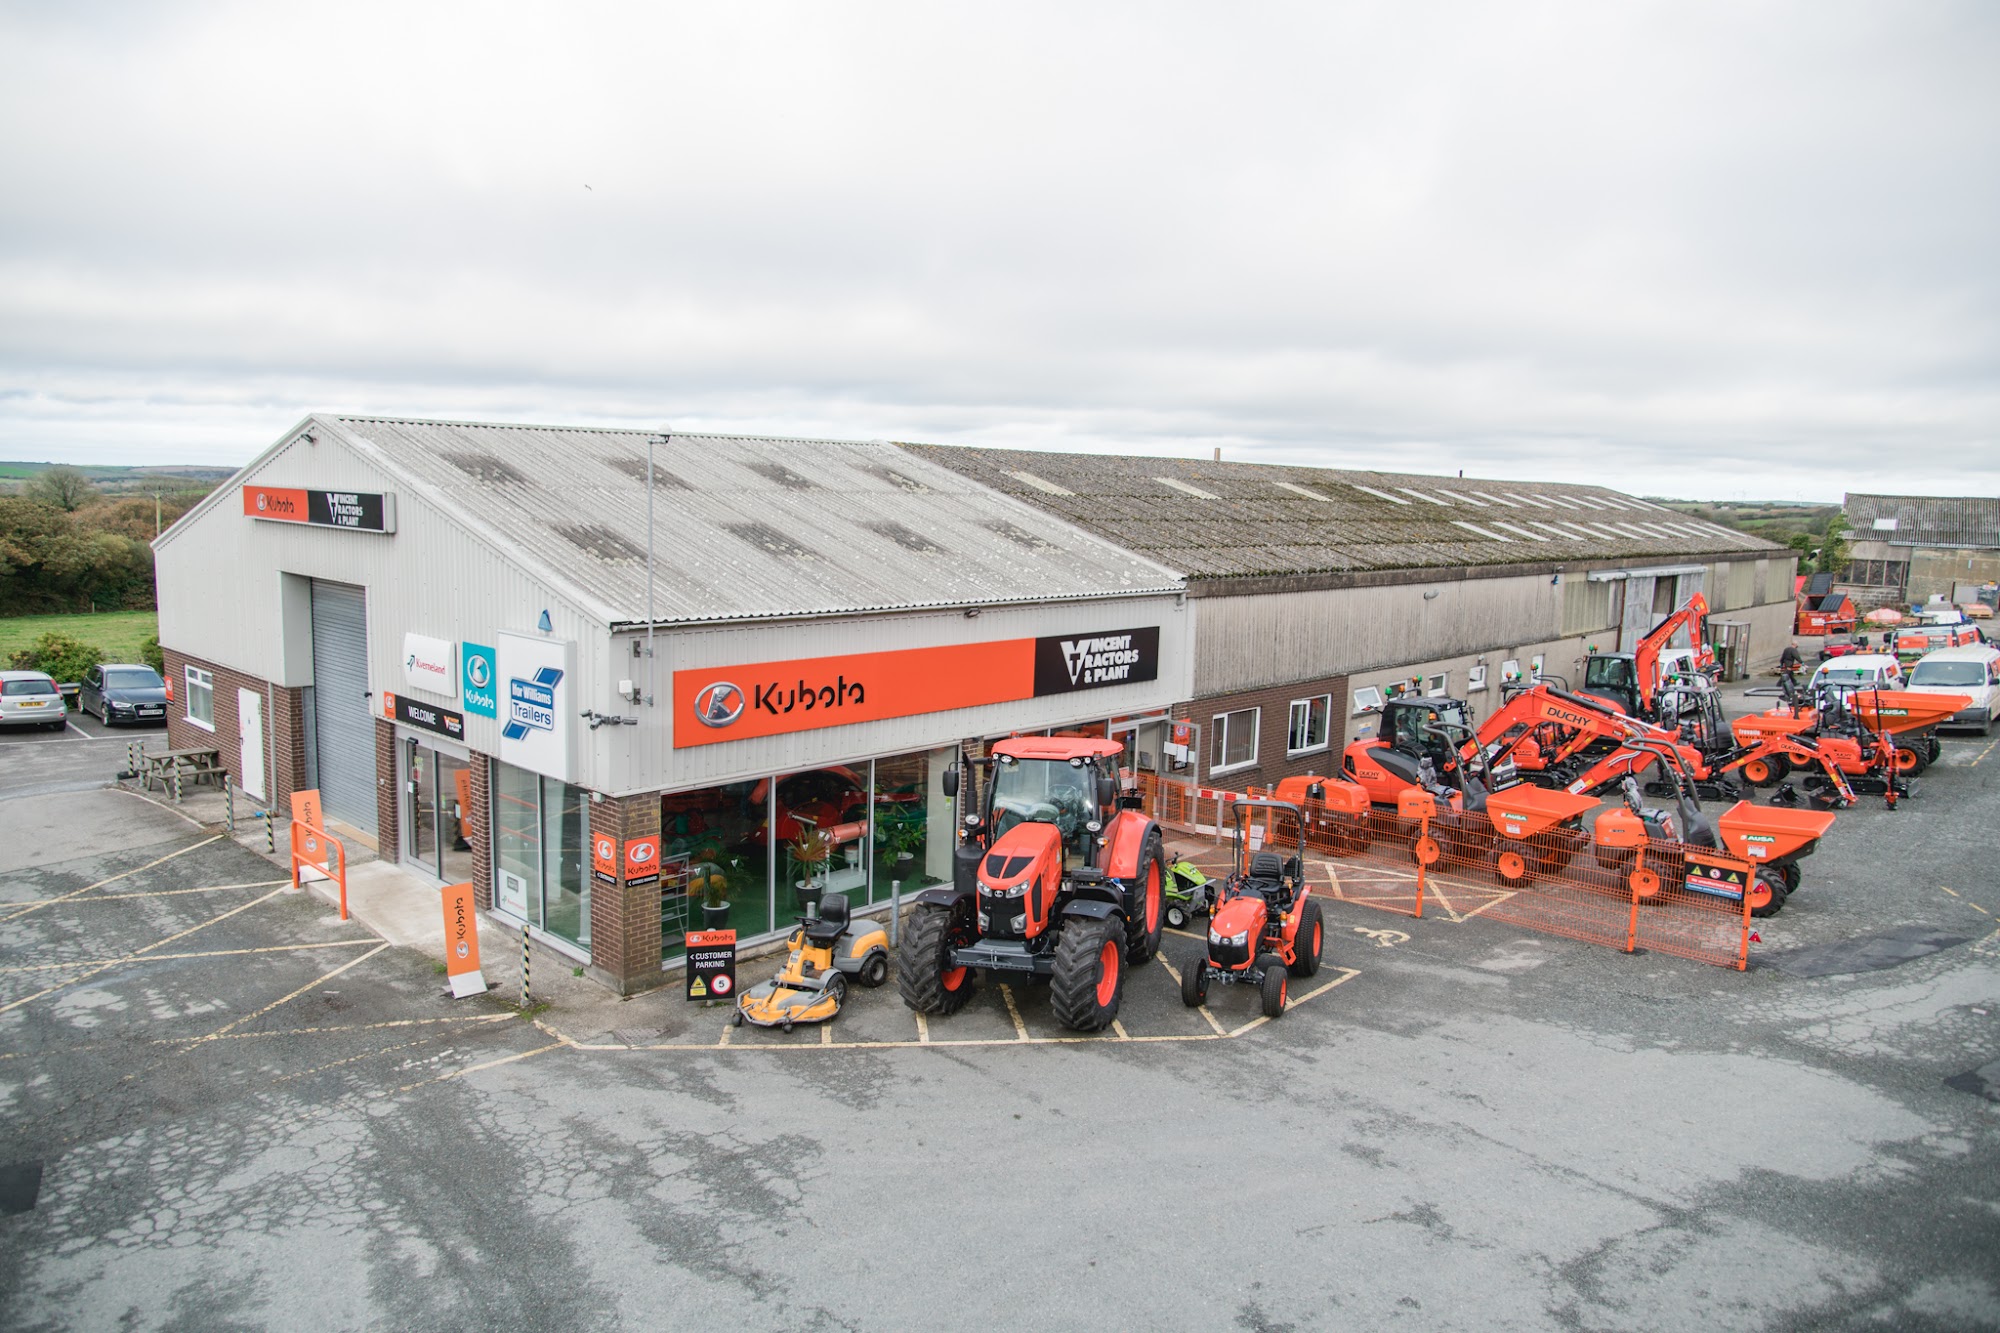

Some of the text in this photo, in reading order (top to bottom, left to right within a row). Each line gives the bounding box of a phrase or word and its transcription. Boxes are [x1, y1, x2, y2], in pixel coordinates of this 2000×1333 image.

[266, 495, 294, 513] Kubota
[416, 658, 446, 675] Kverneland
[1084, 665, 1129, 683] & PLANT
[465, 688, 494, 709] Kubota
[522, 685, 552, 705] Williams
[754, 675, 865, 715] Kubota
[408, 705, 436, 725] WELCOME
[513, 702, 551, 725] Trailers
[1547, 706, 1591, 726] DUCHY
[628, 863, 657, 875] Kubota
[454, 897, 466, 940] Kubota
[702, 934, 734, 942] Kubota
[695, 951, 733, 960] CUSTOMER
[695, 960, 725, 969] PARKING
[718, 980, 725, 988] 5
